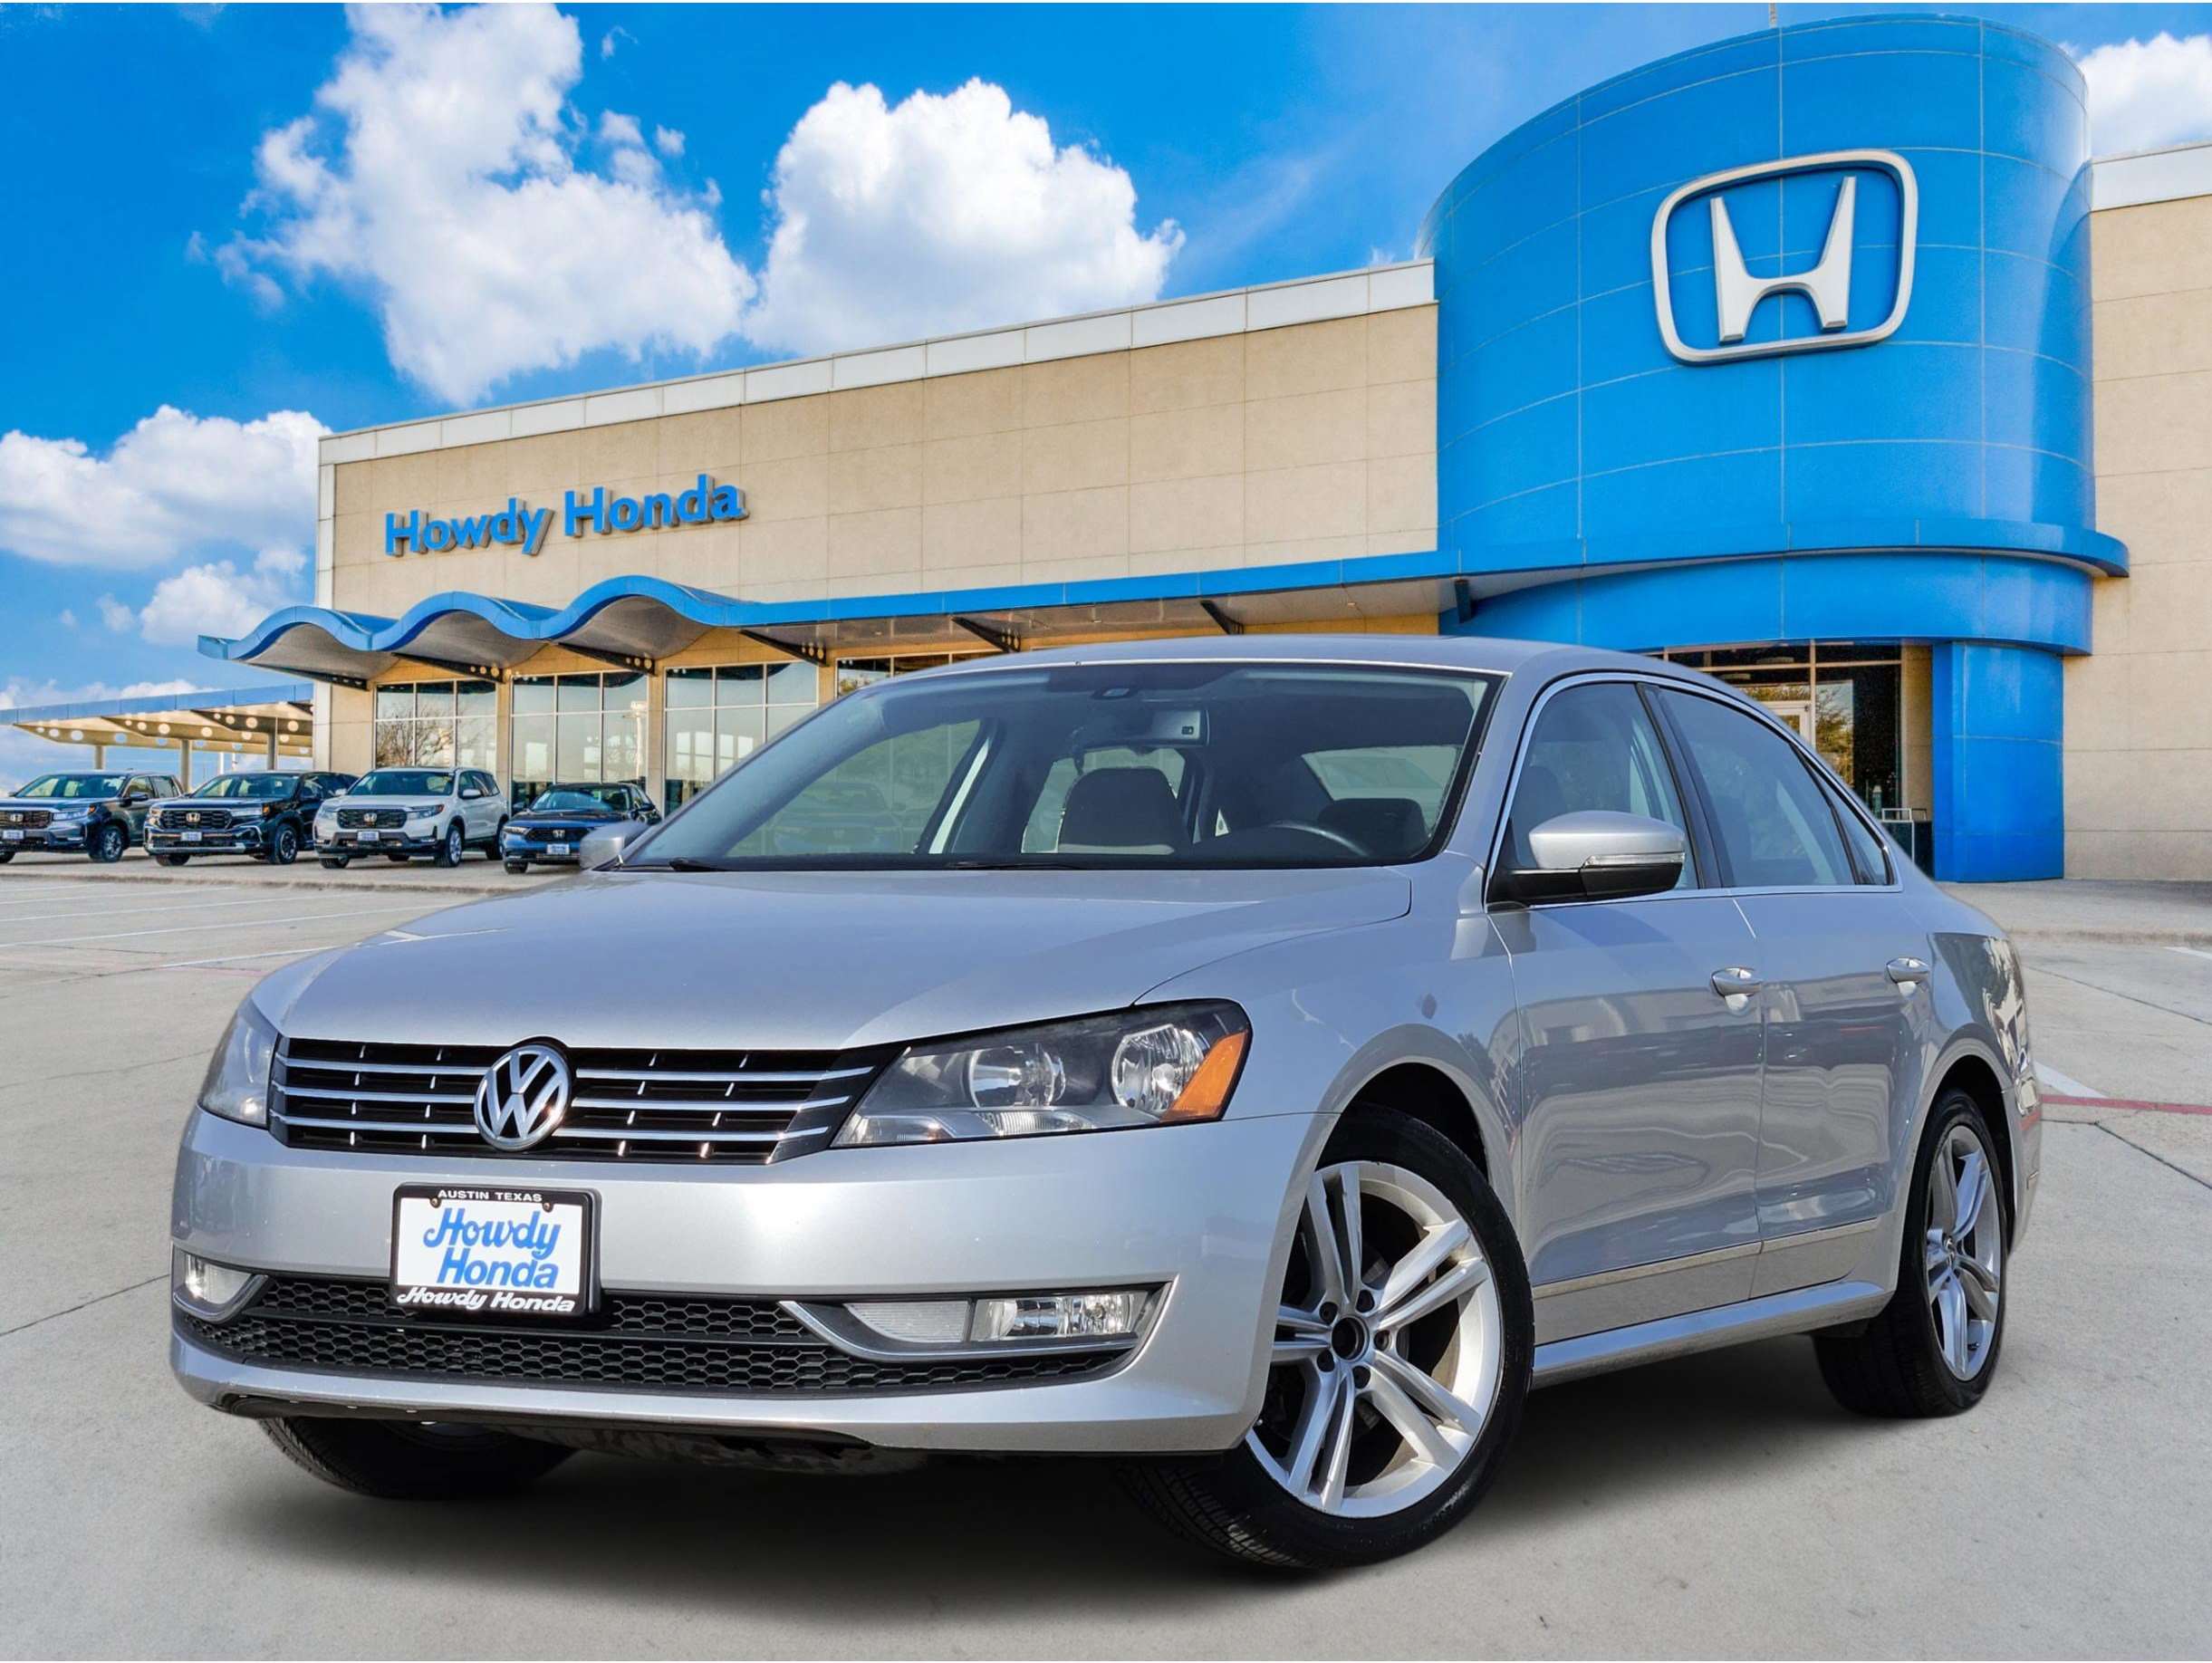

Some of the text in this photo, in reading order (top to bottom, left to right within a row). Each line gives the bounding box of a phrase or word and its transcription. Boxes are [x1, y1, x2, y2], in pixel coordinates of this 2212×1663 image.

[385, 473, 749, 557] Howdy Honda
[438, 1188, 543, 1203] AUSTIN TEXAS
[422, 1207, 562, 1260] Howdy
[436, 1247, 559, 1289] Honda
[396, 1285, 576, 1312] Howdy Honda
